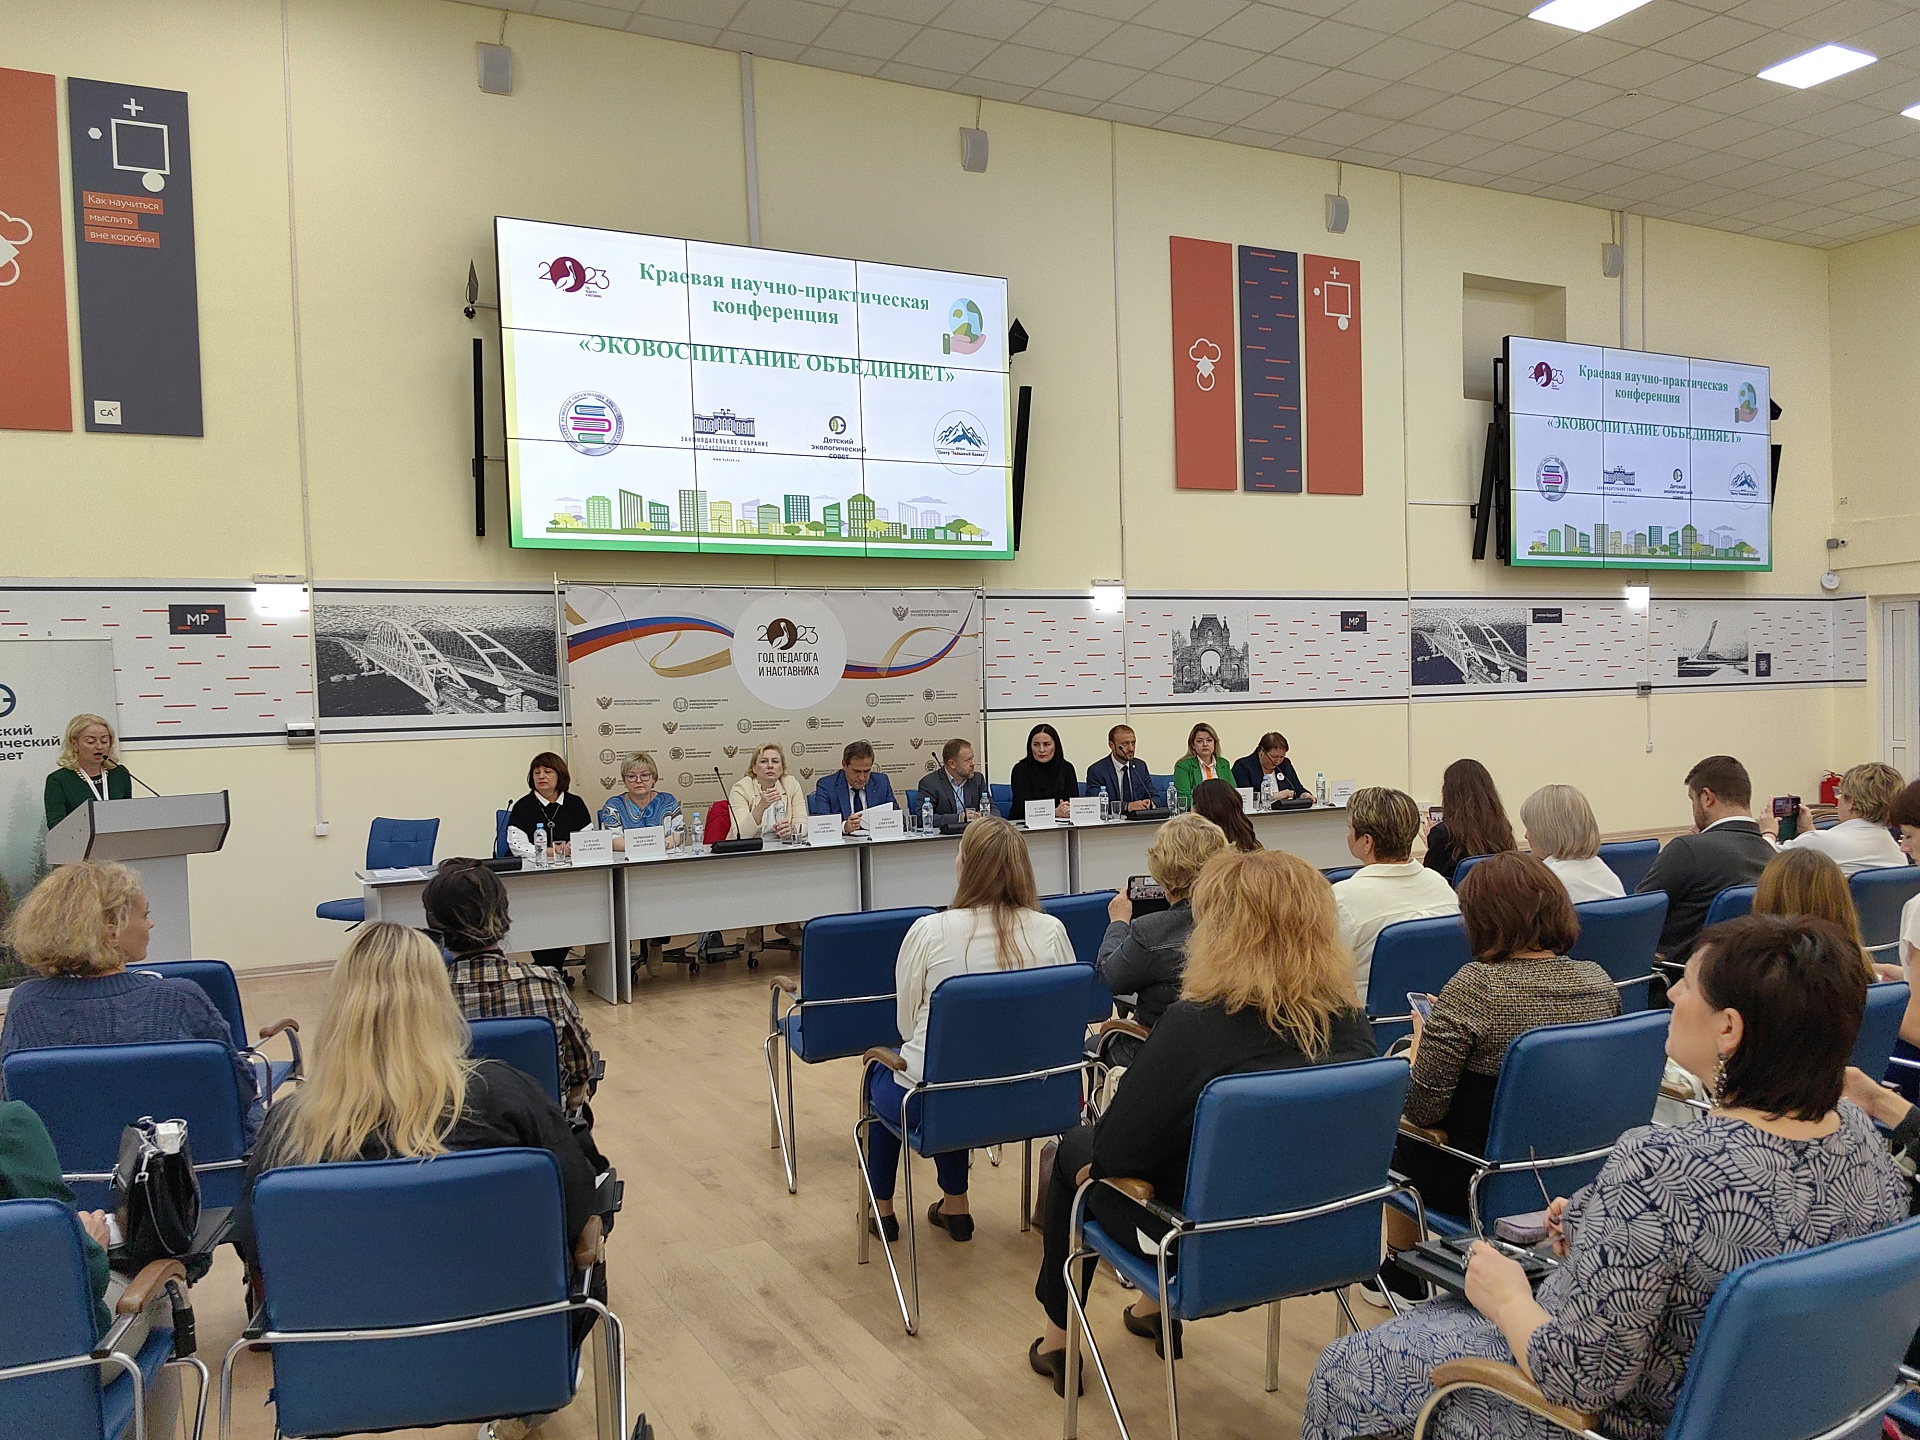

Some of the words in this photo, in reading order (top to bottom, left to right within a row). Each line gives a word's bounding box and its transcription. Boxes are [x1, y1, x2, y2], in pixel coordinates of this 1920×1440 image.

[88, 195, 107, 206] Как
[108, 198, 160, 211] научиться
[89, 214, 133, 225] мыслить
[90, 231, 109, 240] вне
[111, 233, 155, 244] коробки
[639, 262, 724, 289] Краевая
[731, 275, 929, 311] научно-практическая
[712, 299, 839, 325] конференция
[579, 335, 801, 370] «ЭКОВОСПИТАНИЕ
[806, 354, 955, 383] ОБЪЕДИНЯЕТ»
[1579, 364, 1622, 381] Краевая
[1624, 372, 1728, 392] научно-практическая
[1615, 388, 1681, 404] конференция
[1547, 416, 1660, 437] «ЭКОВОСПИТАНИЕ
[1662, 425, 1742, 443] ОБЪЕДИНЯЕТ»
[739, 439, 769, 448] СОБРАНИЕ
[822, 436, 854, 446] Детский
[811, 443, 867, 454] экологический
[758, 652, 775, 664] ГОД
[777, 652, 819, 664] ПЕДАГОГА
[758, 666, 765, 677] И
[766, 665, 820, 677] НАСТАВНИКА
